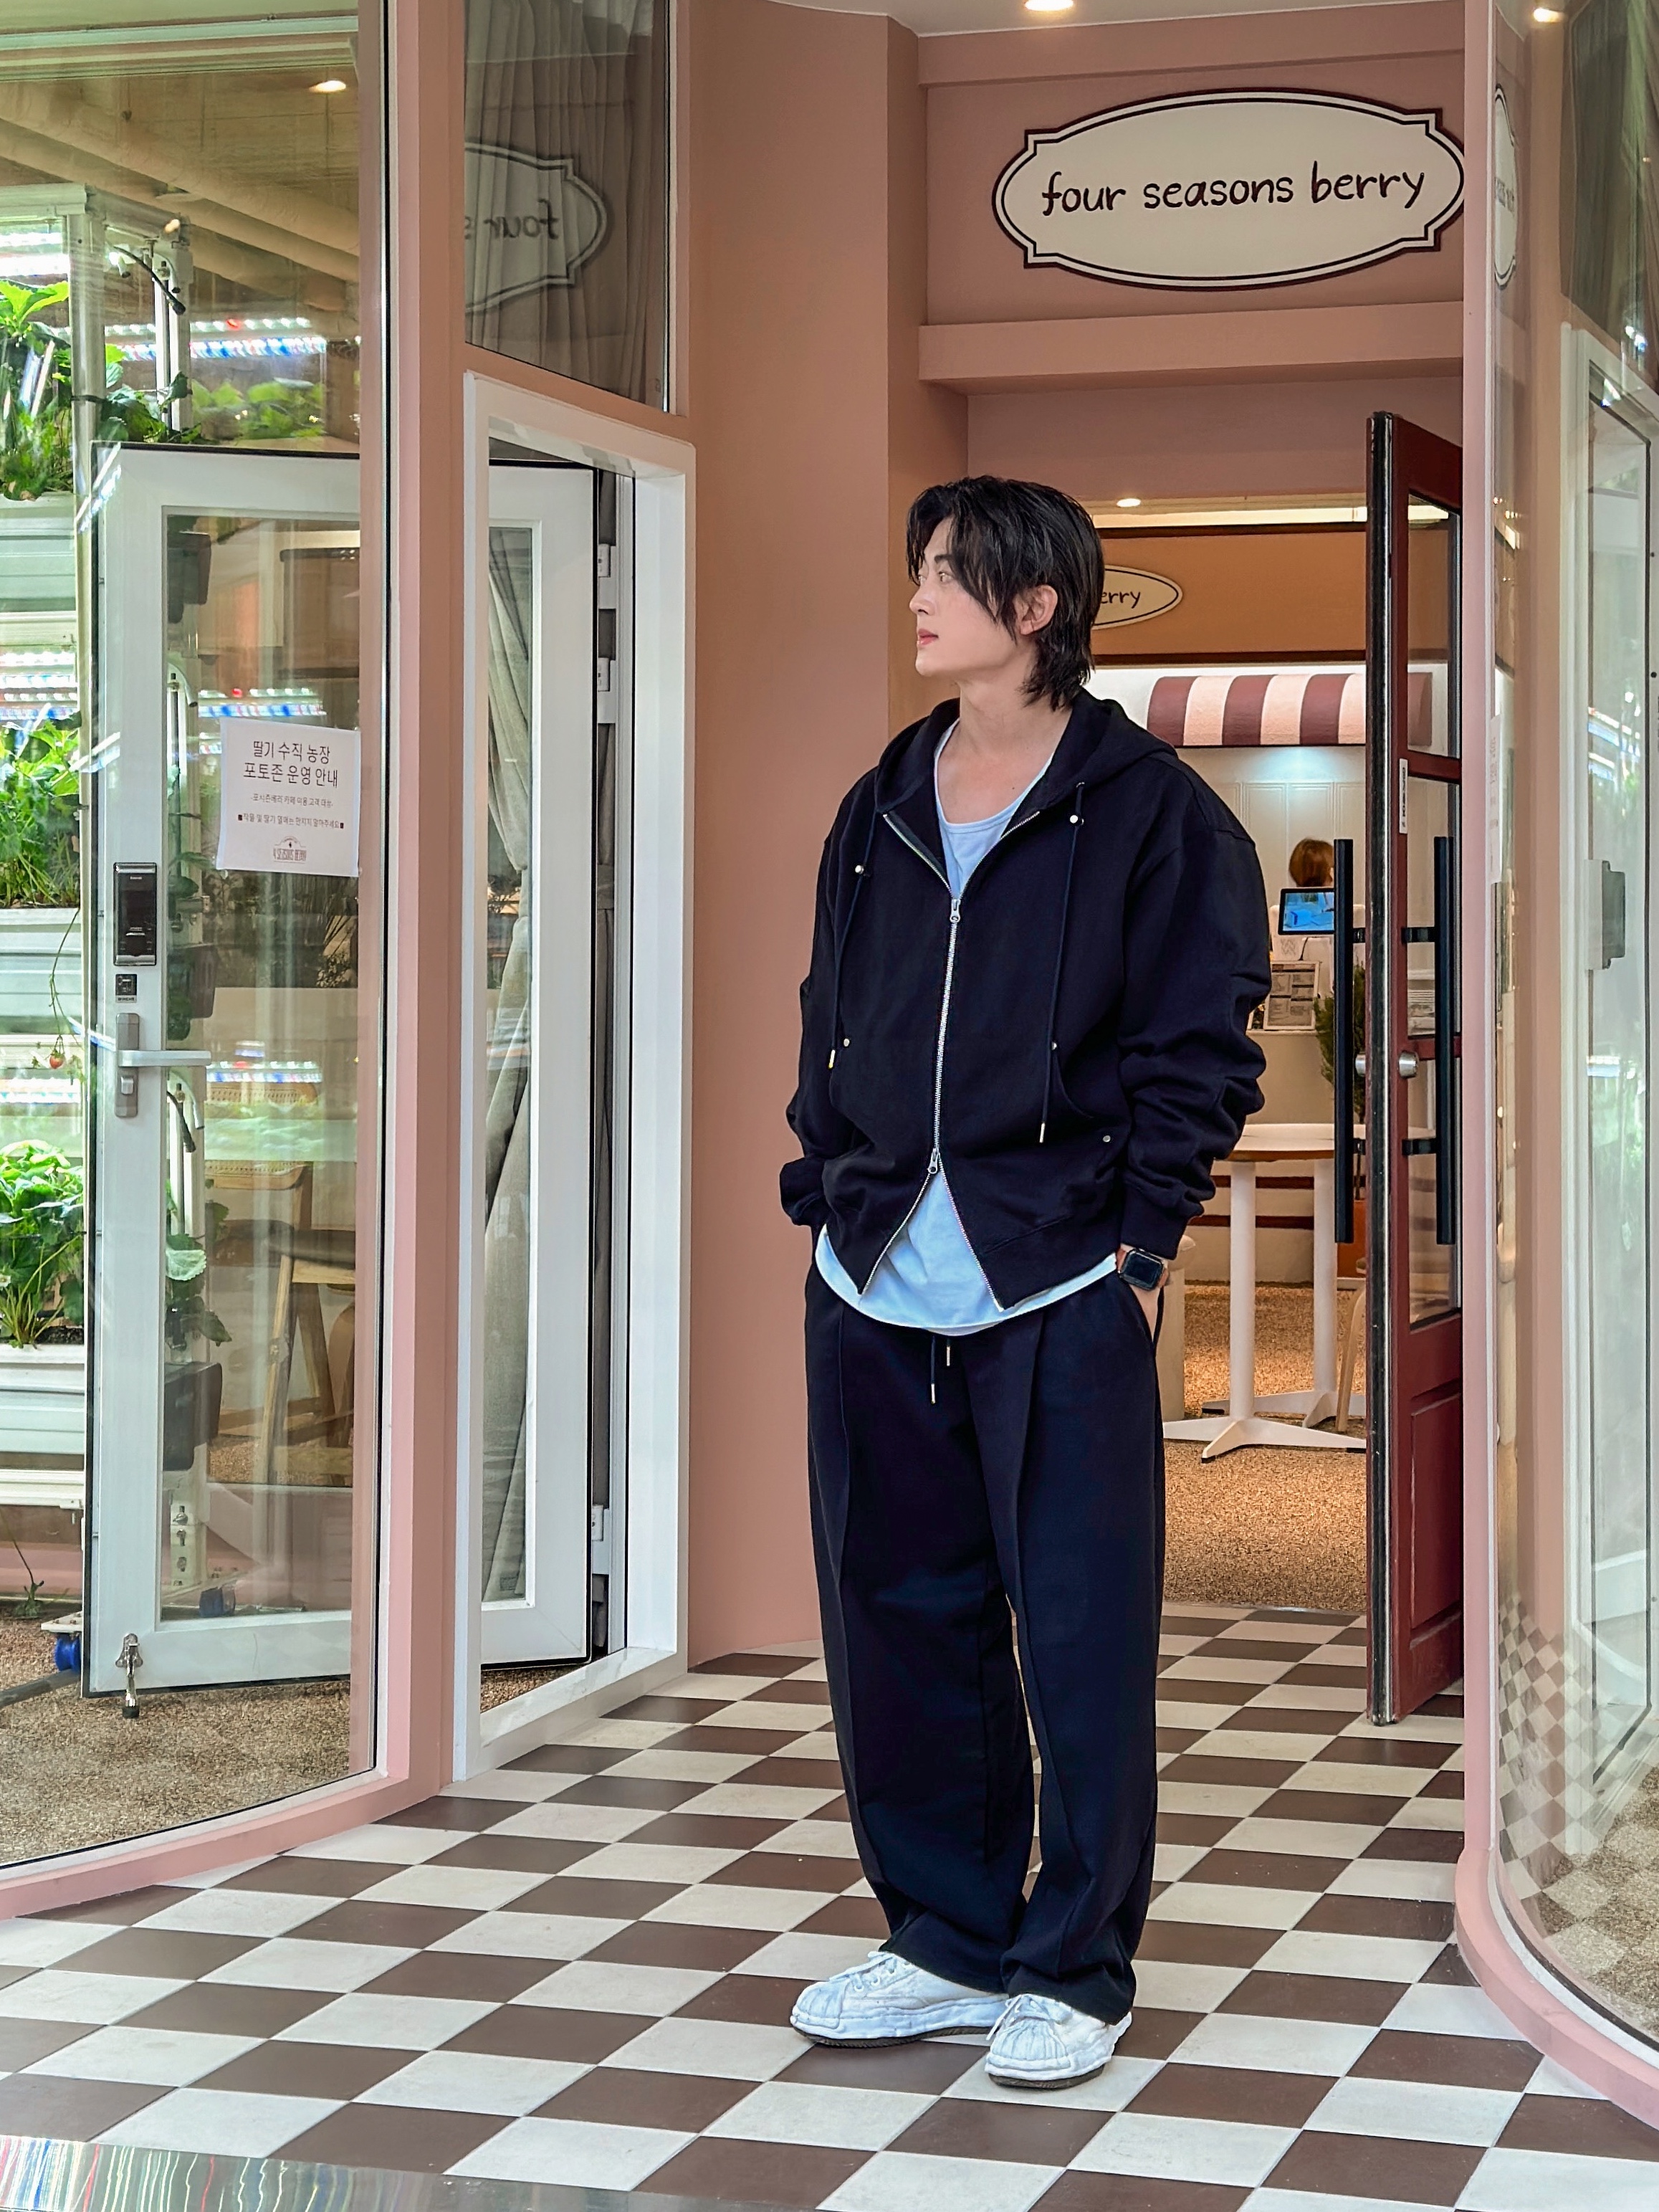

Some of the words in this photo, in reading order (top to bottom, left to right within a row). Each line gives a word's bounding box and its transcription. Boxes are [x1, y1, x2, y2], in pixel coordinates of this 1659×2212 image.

[1041, 171, 1127, 216] four
[1143, 176, 1295, 209] seasons
[1311, 160, 1425, 209] berry
[1100, 591, 1141, 609] erry
[254, 740, 274, 758] 딸기
[278, 742, 302, 762] 수직
[307, 744, 330, 764] 농장
[243, 762, 284, 783] 포토존
[287, 765, 311, 786] 운영
[315, 768, 338, 788] 안내
